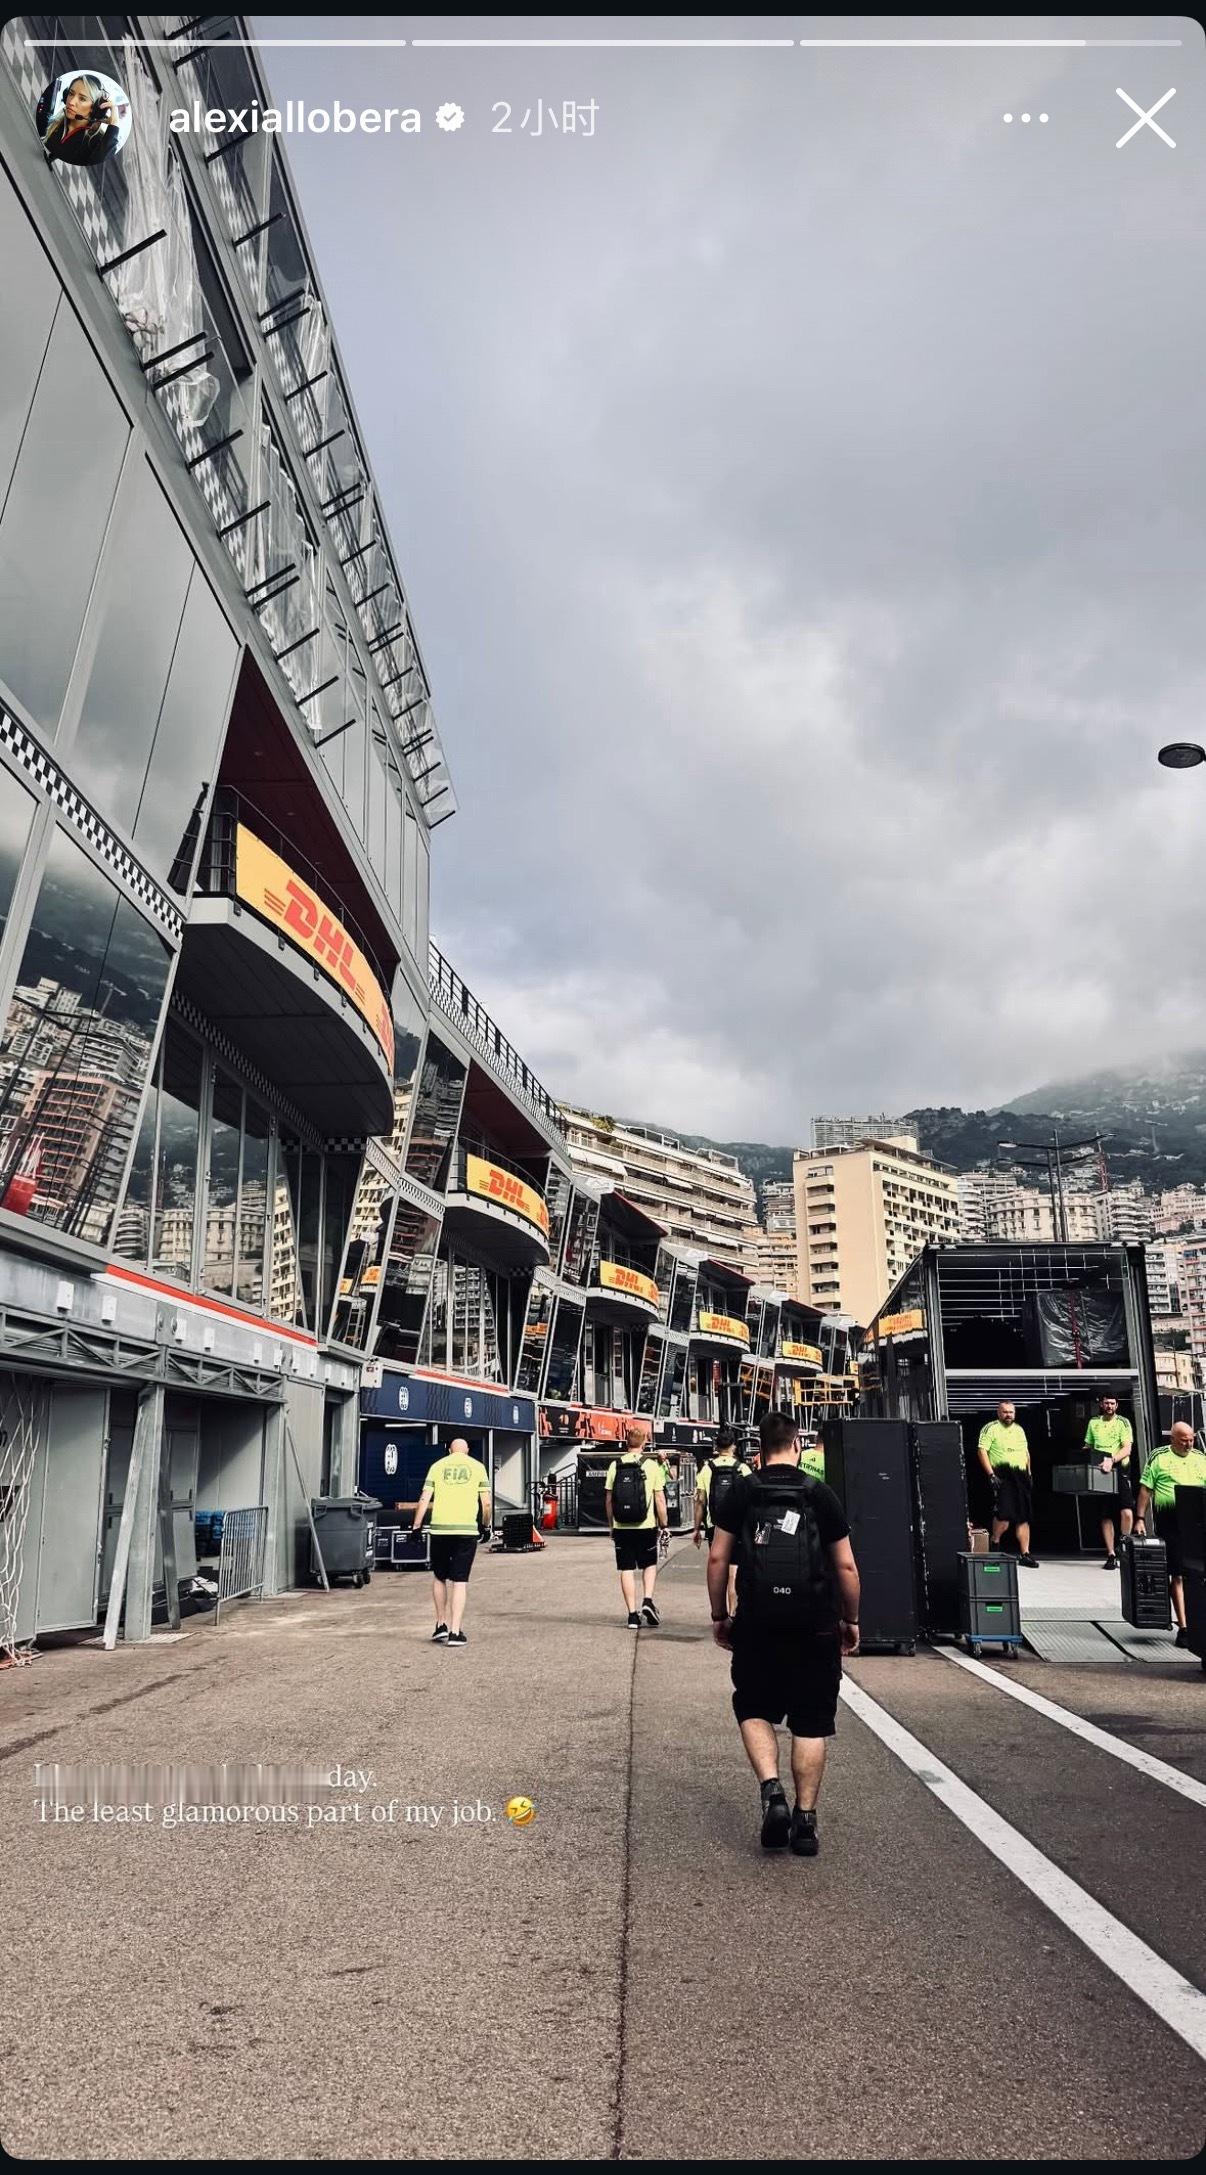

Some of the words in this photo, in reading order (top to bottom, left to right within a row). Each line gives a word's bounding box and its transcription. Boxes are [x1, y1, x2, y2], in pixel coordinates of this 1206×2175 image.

[283, 878, 357, 992] DHL
[488, 1168, 526, 1211] DHL
[614, 1267, 640, 1291] DHL
